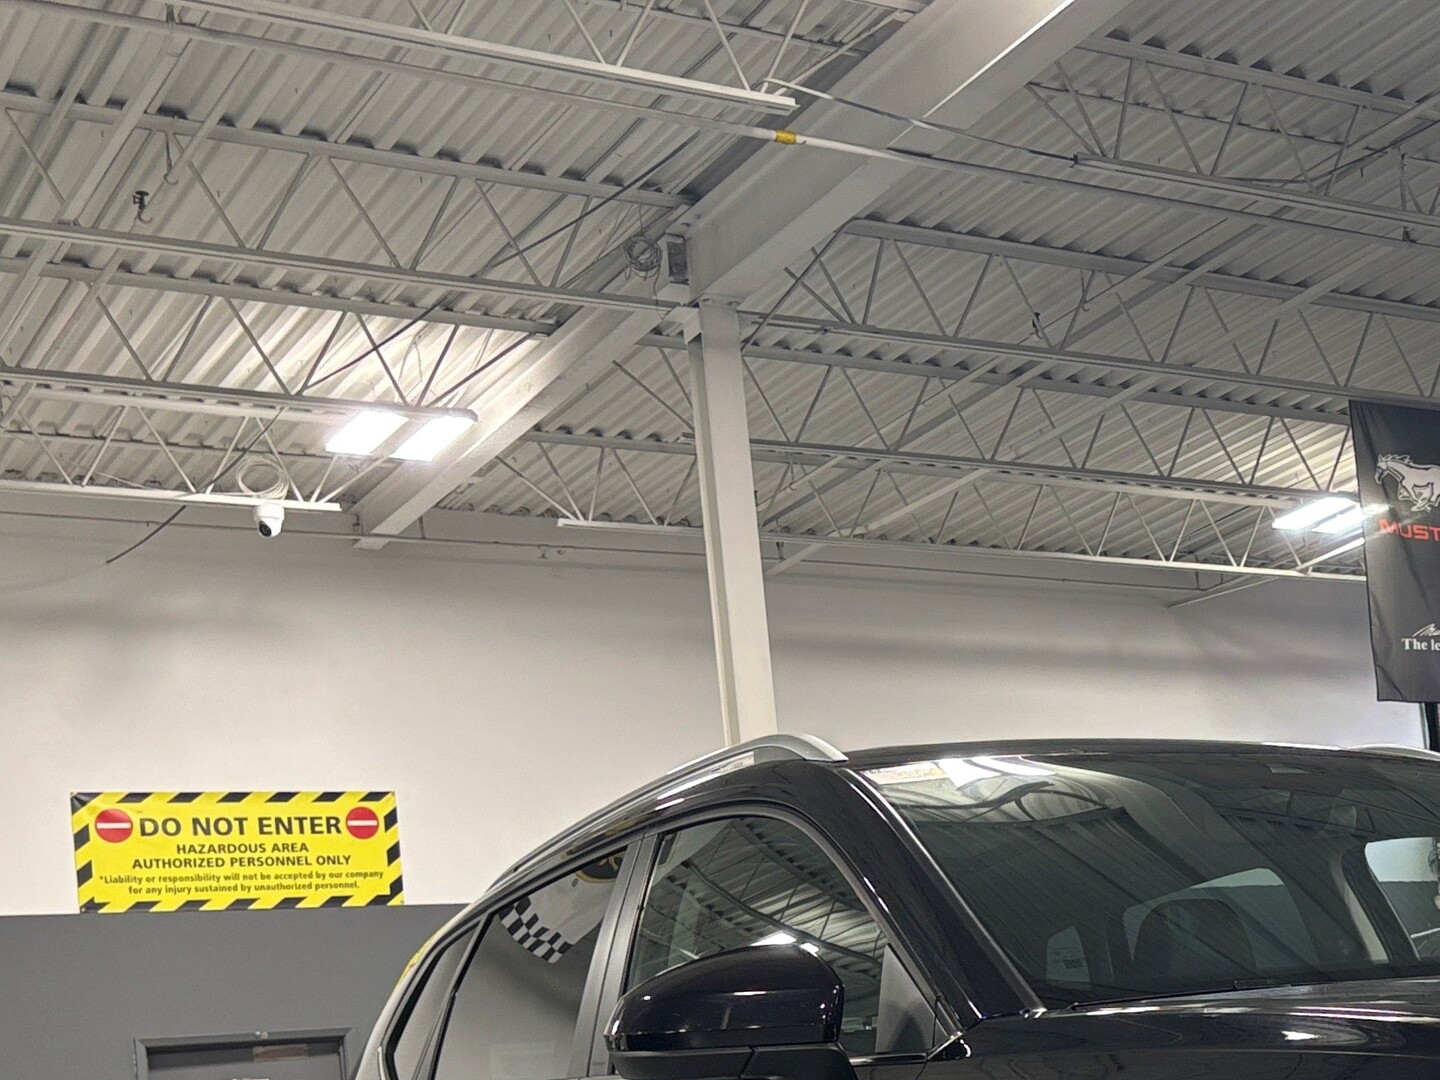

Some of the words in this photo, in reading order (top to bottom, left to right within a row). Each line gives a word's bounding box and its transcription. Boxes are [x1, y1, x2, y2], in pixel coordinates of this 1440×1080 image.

[1400, 638, 1428, 651] The
[139, 817, 182, 837] DO
[191, 817, 248, 836] NOT
[257, 816, 342, 835] ENTER
[176, 843, 267, 855] HAZARDOUS
[271, 842, 310, 853] AREA
[132, 857, 226, 870] AUTHORIZED
[230, 856, 313, 867] PERSONNEL
[315, 854, 352, 866] ONLY
[158, 873, 221, 884] responsibility
[223, 873, 240, 881] will
[260, 872, 272, 880] be
[274, 871, 314, 882] accepted
[315, 870, 326, 881] by
[345, 870, 384, 880] company
[128, 885, 142, 894] for
[145, 886, 162, 895] any
[165, 885, 192, 895] injury
[194, 884, 238, 893] sustained
[240, 883, 251, 893] by
[254, 881, 313, 891] unauthorized
